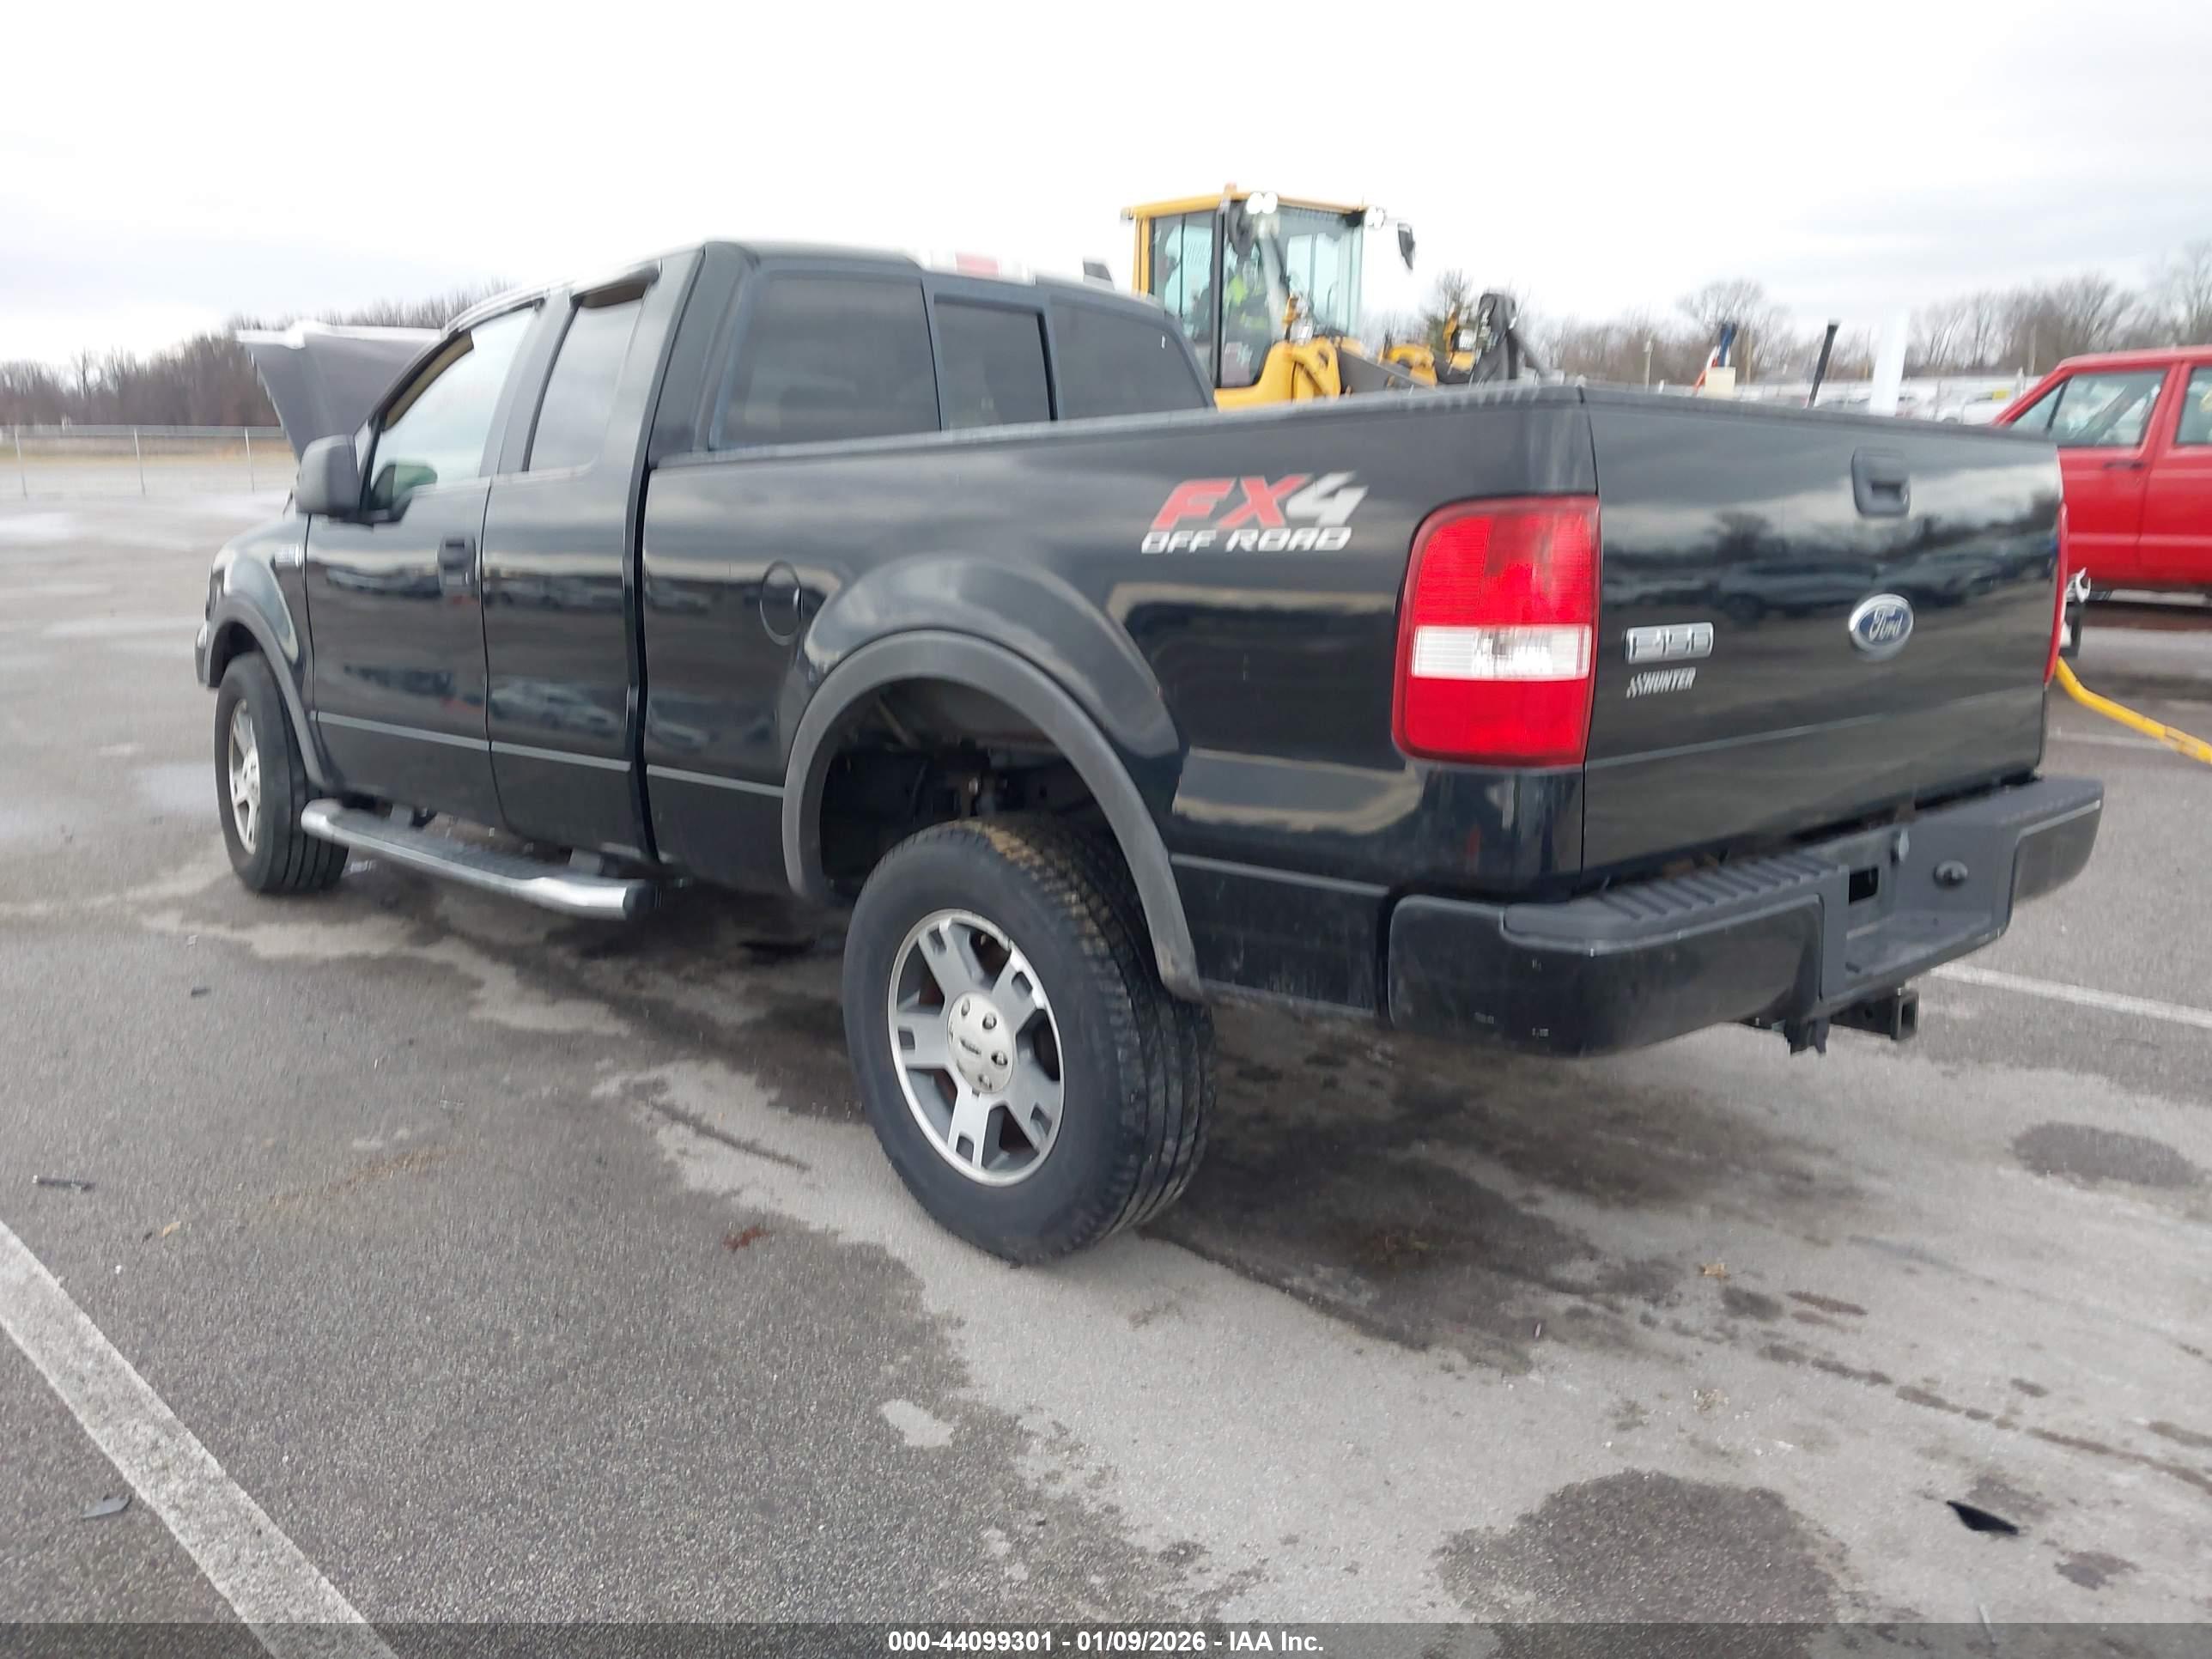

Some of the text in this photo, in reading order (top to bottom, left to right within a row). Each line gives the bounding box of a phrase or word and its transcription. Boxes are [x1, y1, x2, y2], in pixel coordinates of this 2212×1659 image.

[1150, 471, 1369, 532] FX4
[1141, 526, 1352, 554] OFF ROAD
